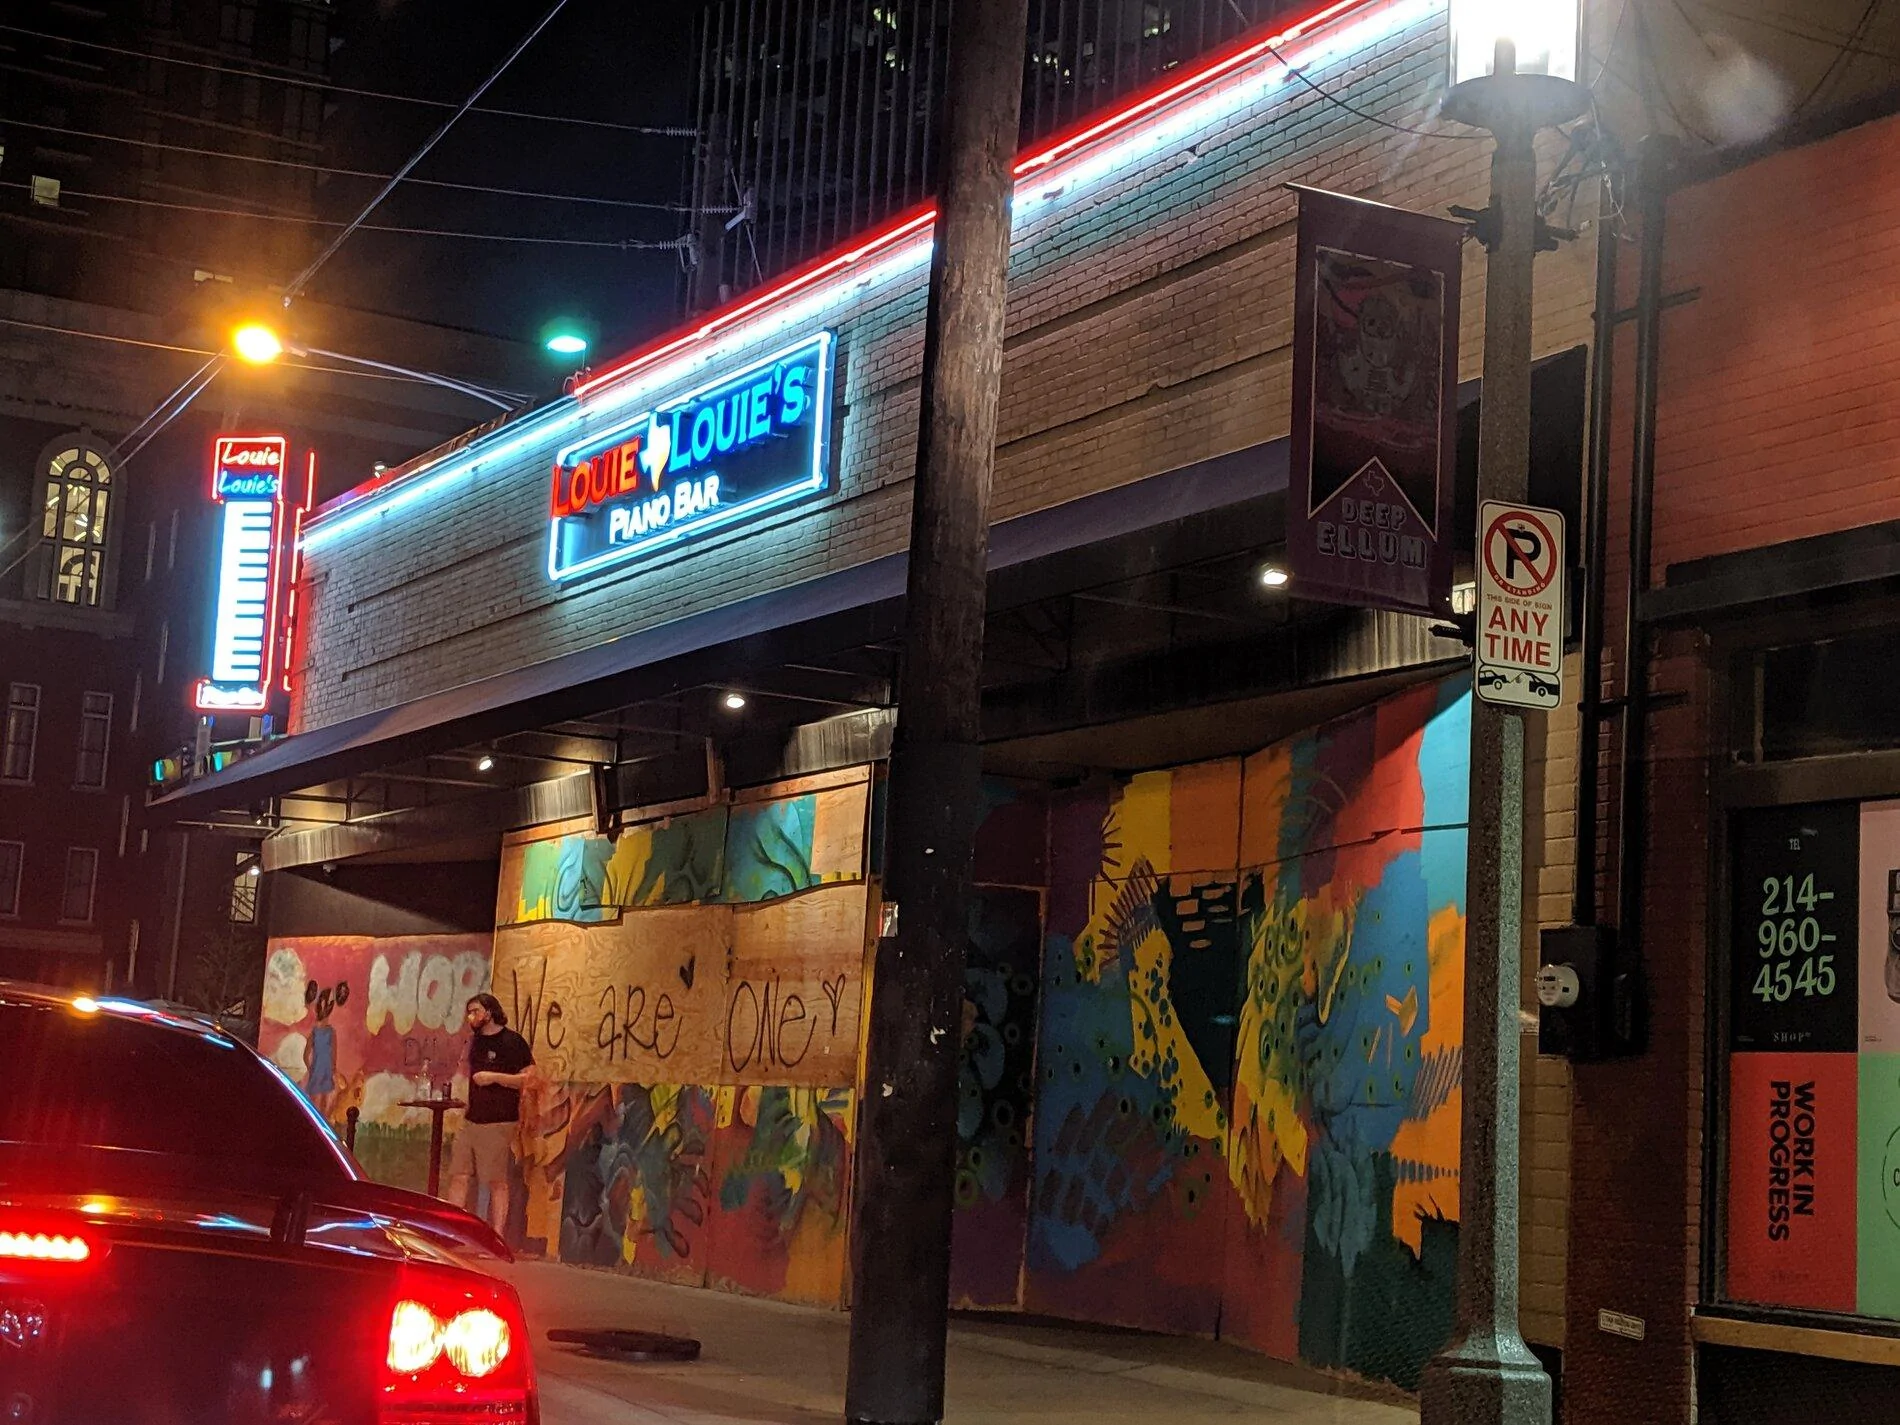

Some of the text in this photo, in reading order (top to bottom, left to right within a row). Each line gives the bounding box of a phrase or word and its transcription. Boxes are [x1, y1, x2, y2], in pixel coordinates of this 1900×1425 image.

[221, 442, 280, 466] Louie
[551, 363, 810, 518] LOUIE LOUIE'S
[218, 470, 278, 494] Louie's
[609, 474, 721, 545] PIANO BAR
[1341, 497, 1408, 531] DEEP
[1316, 521, 1427, 570] ELLUM
[1486, 593, 1503, 603] THIS
[1504, 596, 1521, 606] SIDE
[1534, 602, 1553, 611] SIGN
[1507, 582, 1546, 595] STANDING
[1488, 605, 1550, 636] ANY
[1484, 632, 1552, 667] TIME
[1761, 872, 1835, 916] 214-
[1757, 916, 1837, 959] 960-
[1752, 954, 1836, 1003] 4545
[512, 955, 566, 1050] We
[1767, 1080, 1791, 1242] PROGRESS
[1792, 1080, 1816, 1217] WORK IN
